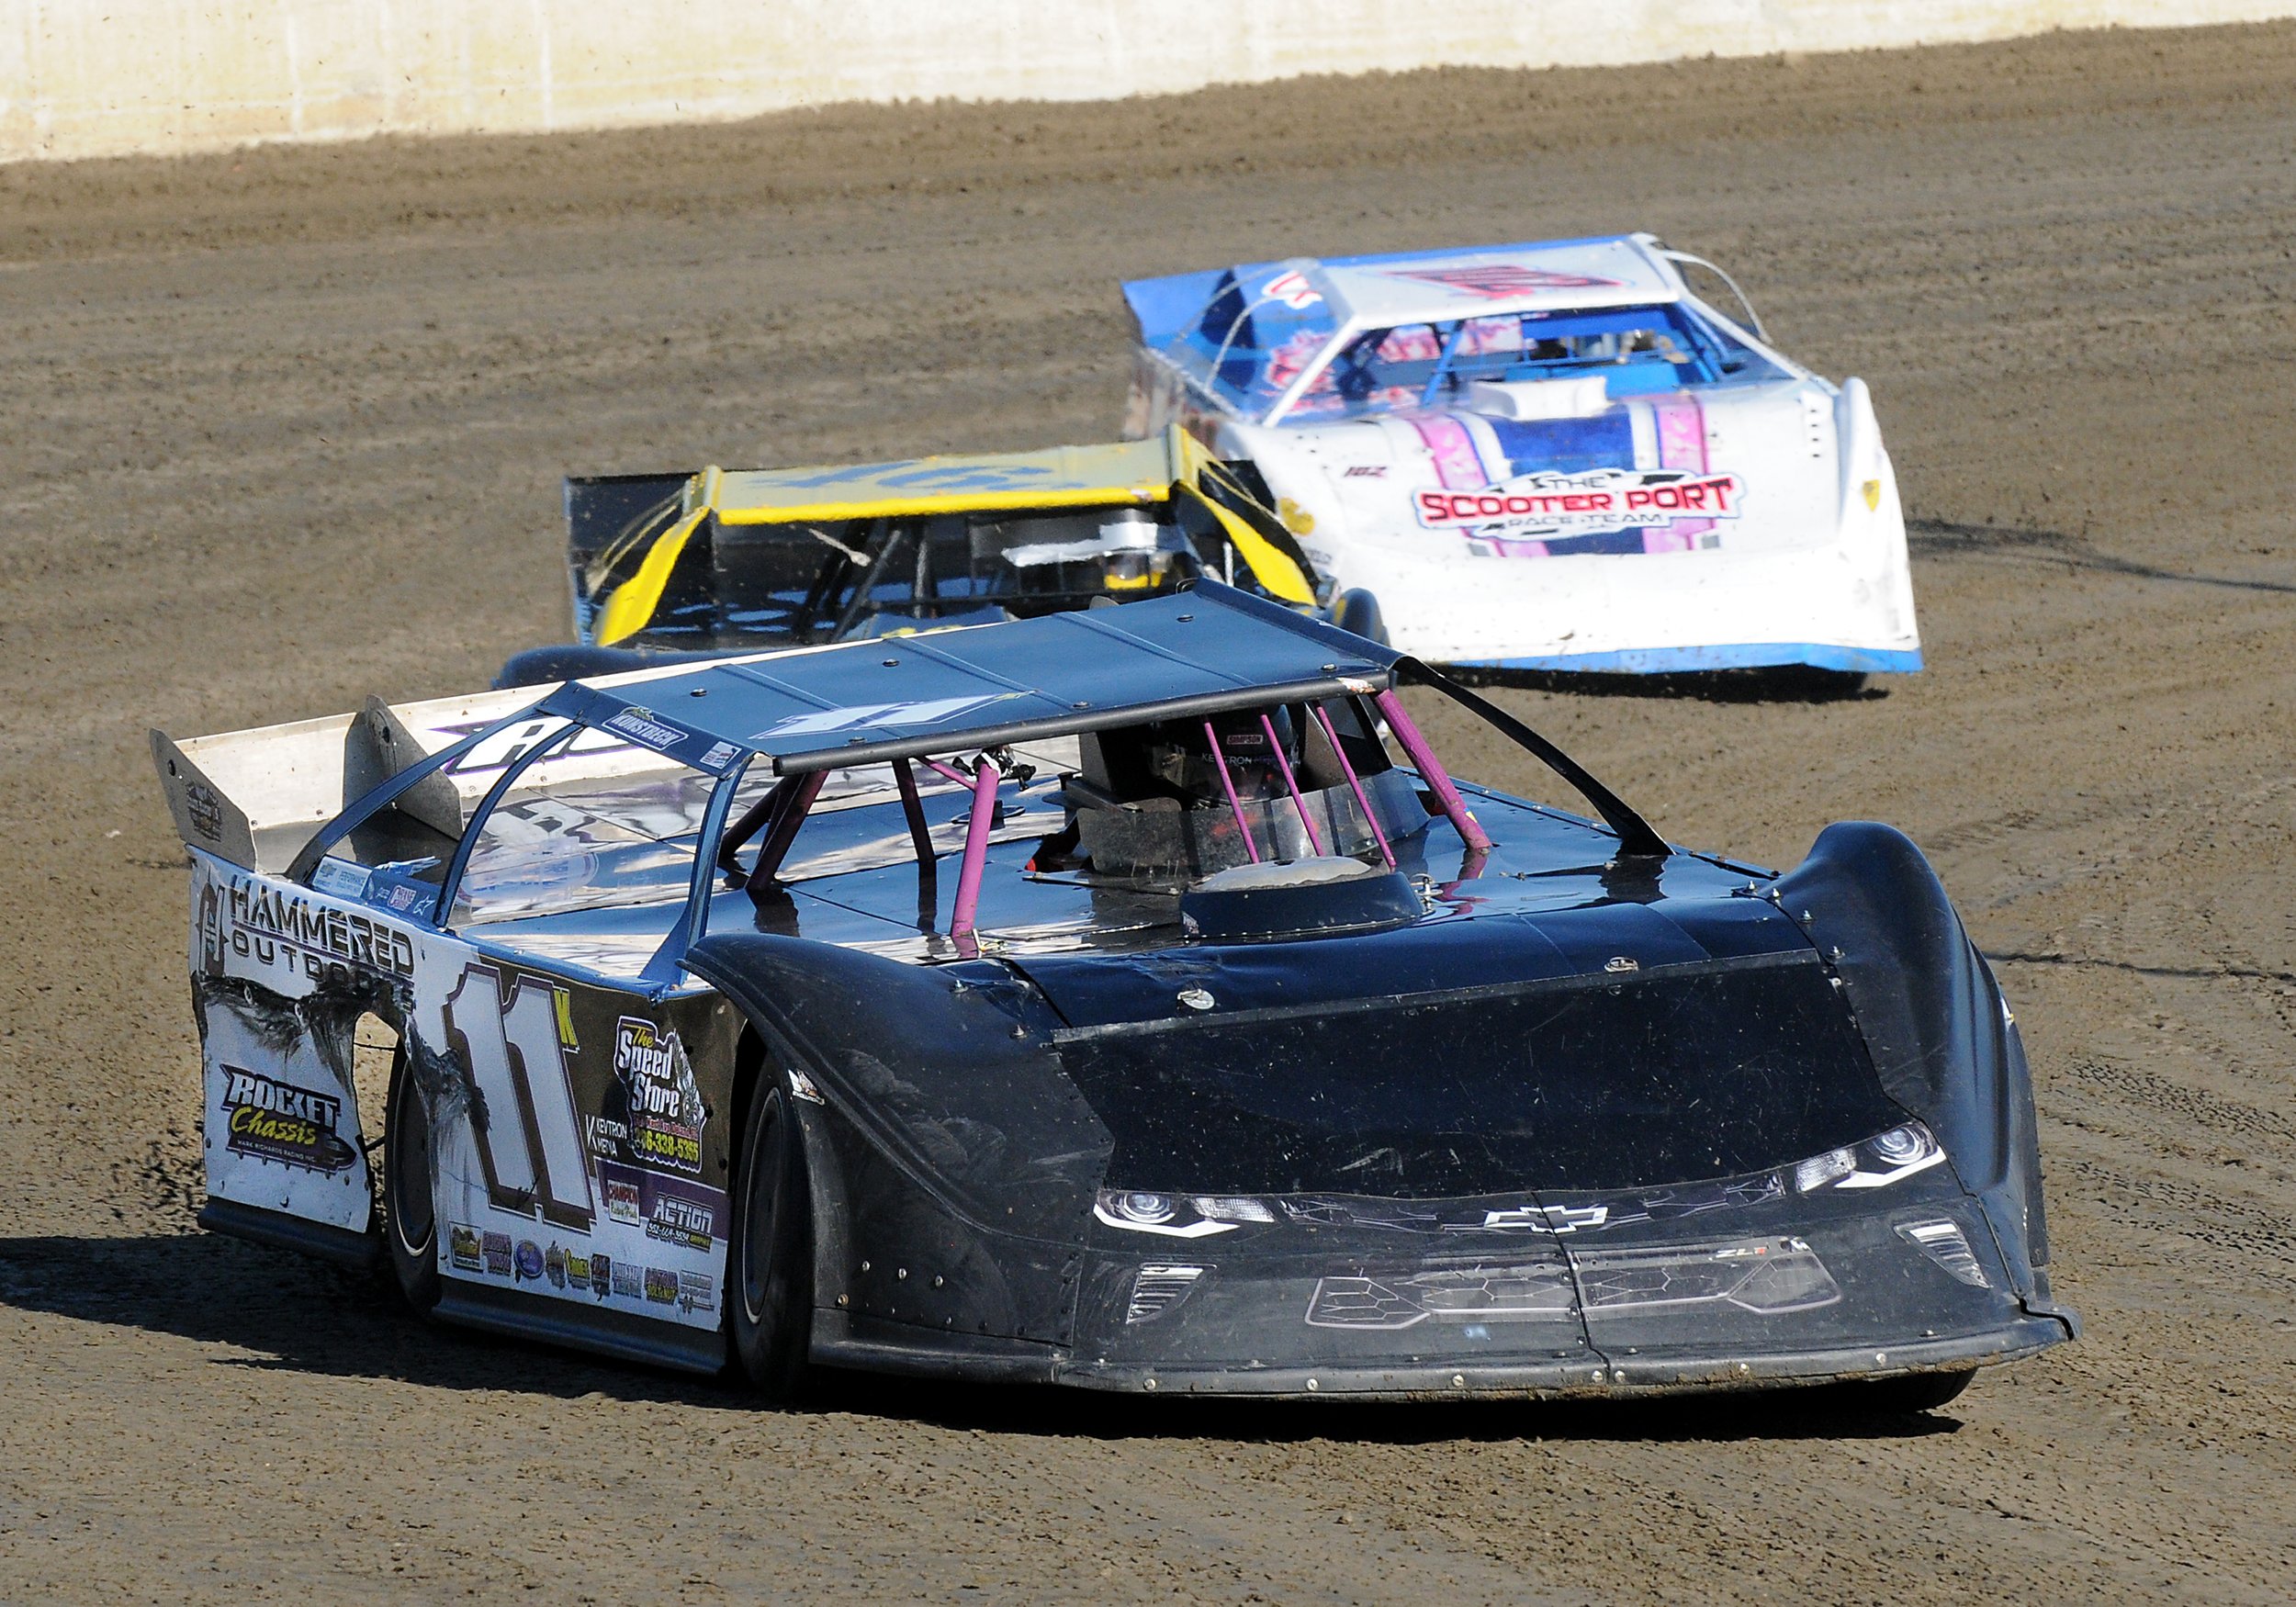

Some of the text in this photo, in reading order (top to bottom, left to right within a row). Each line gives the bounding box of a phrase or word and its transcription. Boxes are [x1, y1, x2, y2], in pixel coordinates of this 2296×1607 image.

[1421, 478, 1733, 522] SCOOTER PORT
[1547, 477, 1605, 488] THE
[1509, 512, 1662, 524] RACE TEAM
[1228, 736, 1262, 744] SIMPSON
[230, 874, 415, 977] HAMMERED
[618, 1030, 673, 1080] Speed
[623, 1024, 655, 1048] The
[229, 1073, 337, 1128] ROCKET
[631, 1073, 680, 1118] Store
[231, 1106, 316, 1144] Chassis
[596, 1117, 627, 1140] KEVTRON
[653, 1195, 713, 1233] ACTION
